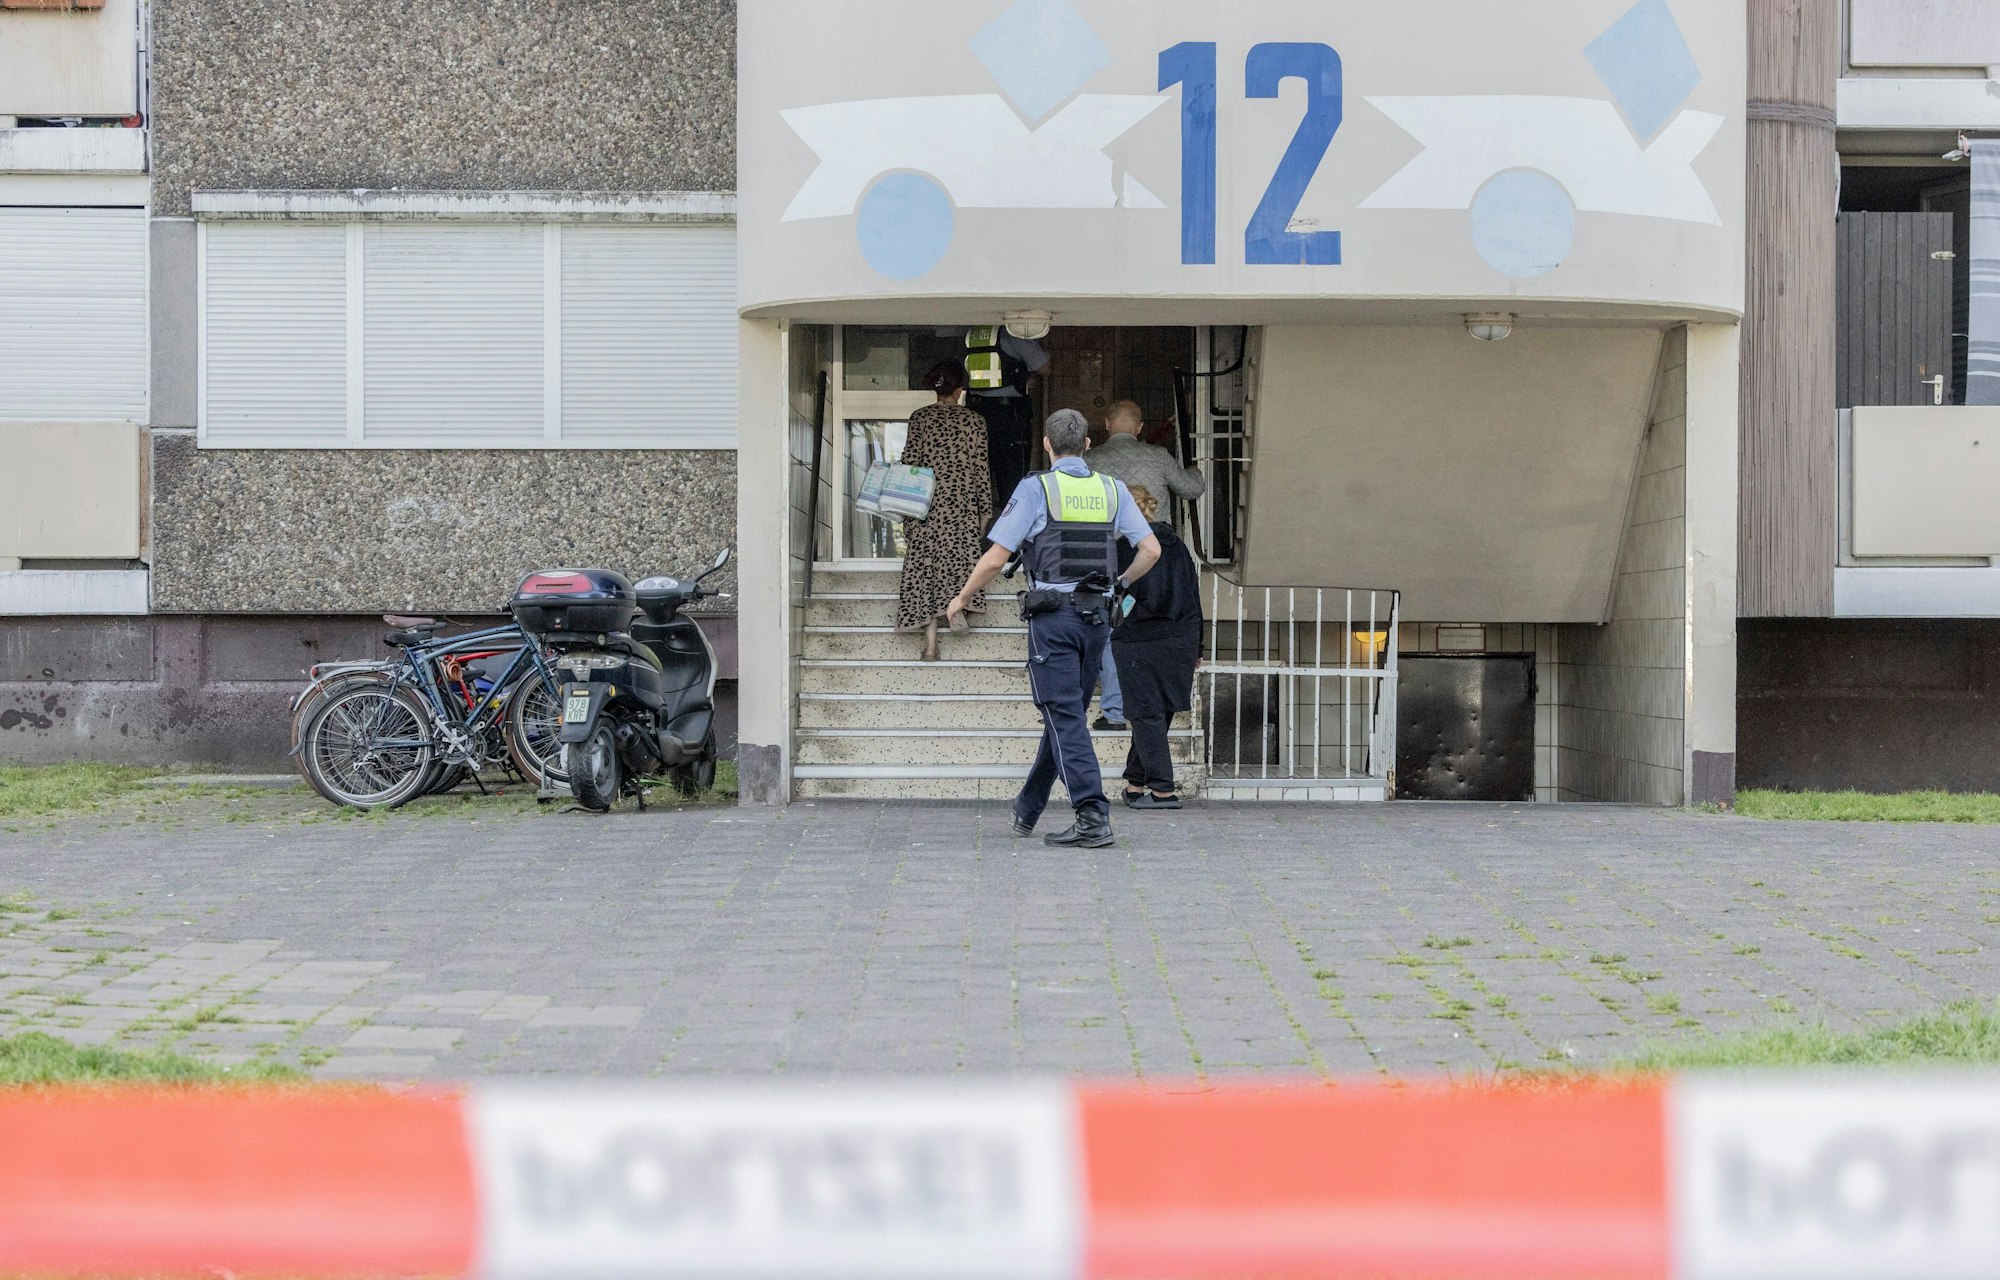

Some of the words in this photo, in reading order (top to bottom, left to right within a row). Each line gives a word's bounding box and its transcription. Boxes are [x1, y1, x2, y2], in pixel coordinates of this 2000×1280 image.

[1158, 41, 1342, 265] 12
[1065, 495, 1104, 510] POLIZEI
[568, 699, 587, 709] 978
